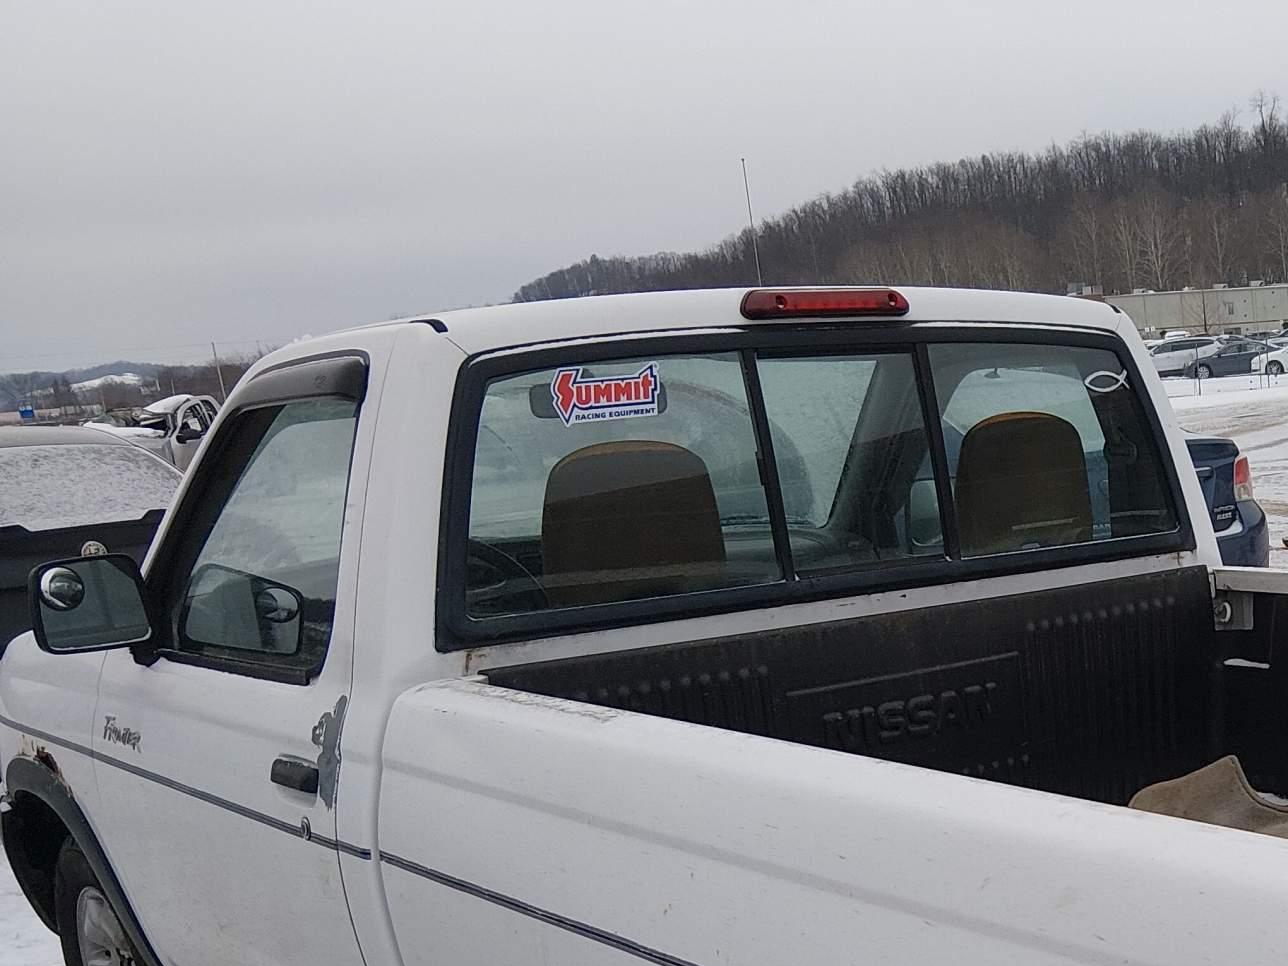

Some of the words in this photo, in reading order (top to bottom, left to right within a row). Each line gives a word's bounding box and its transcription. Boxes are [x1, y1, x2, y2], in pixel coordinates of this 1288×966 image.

[575, 411, 606, 421] RACING
[608, 407, 656, 418] EQUIPMENT
[822, 682, 997, 747] NISSAN
